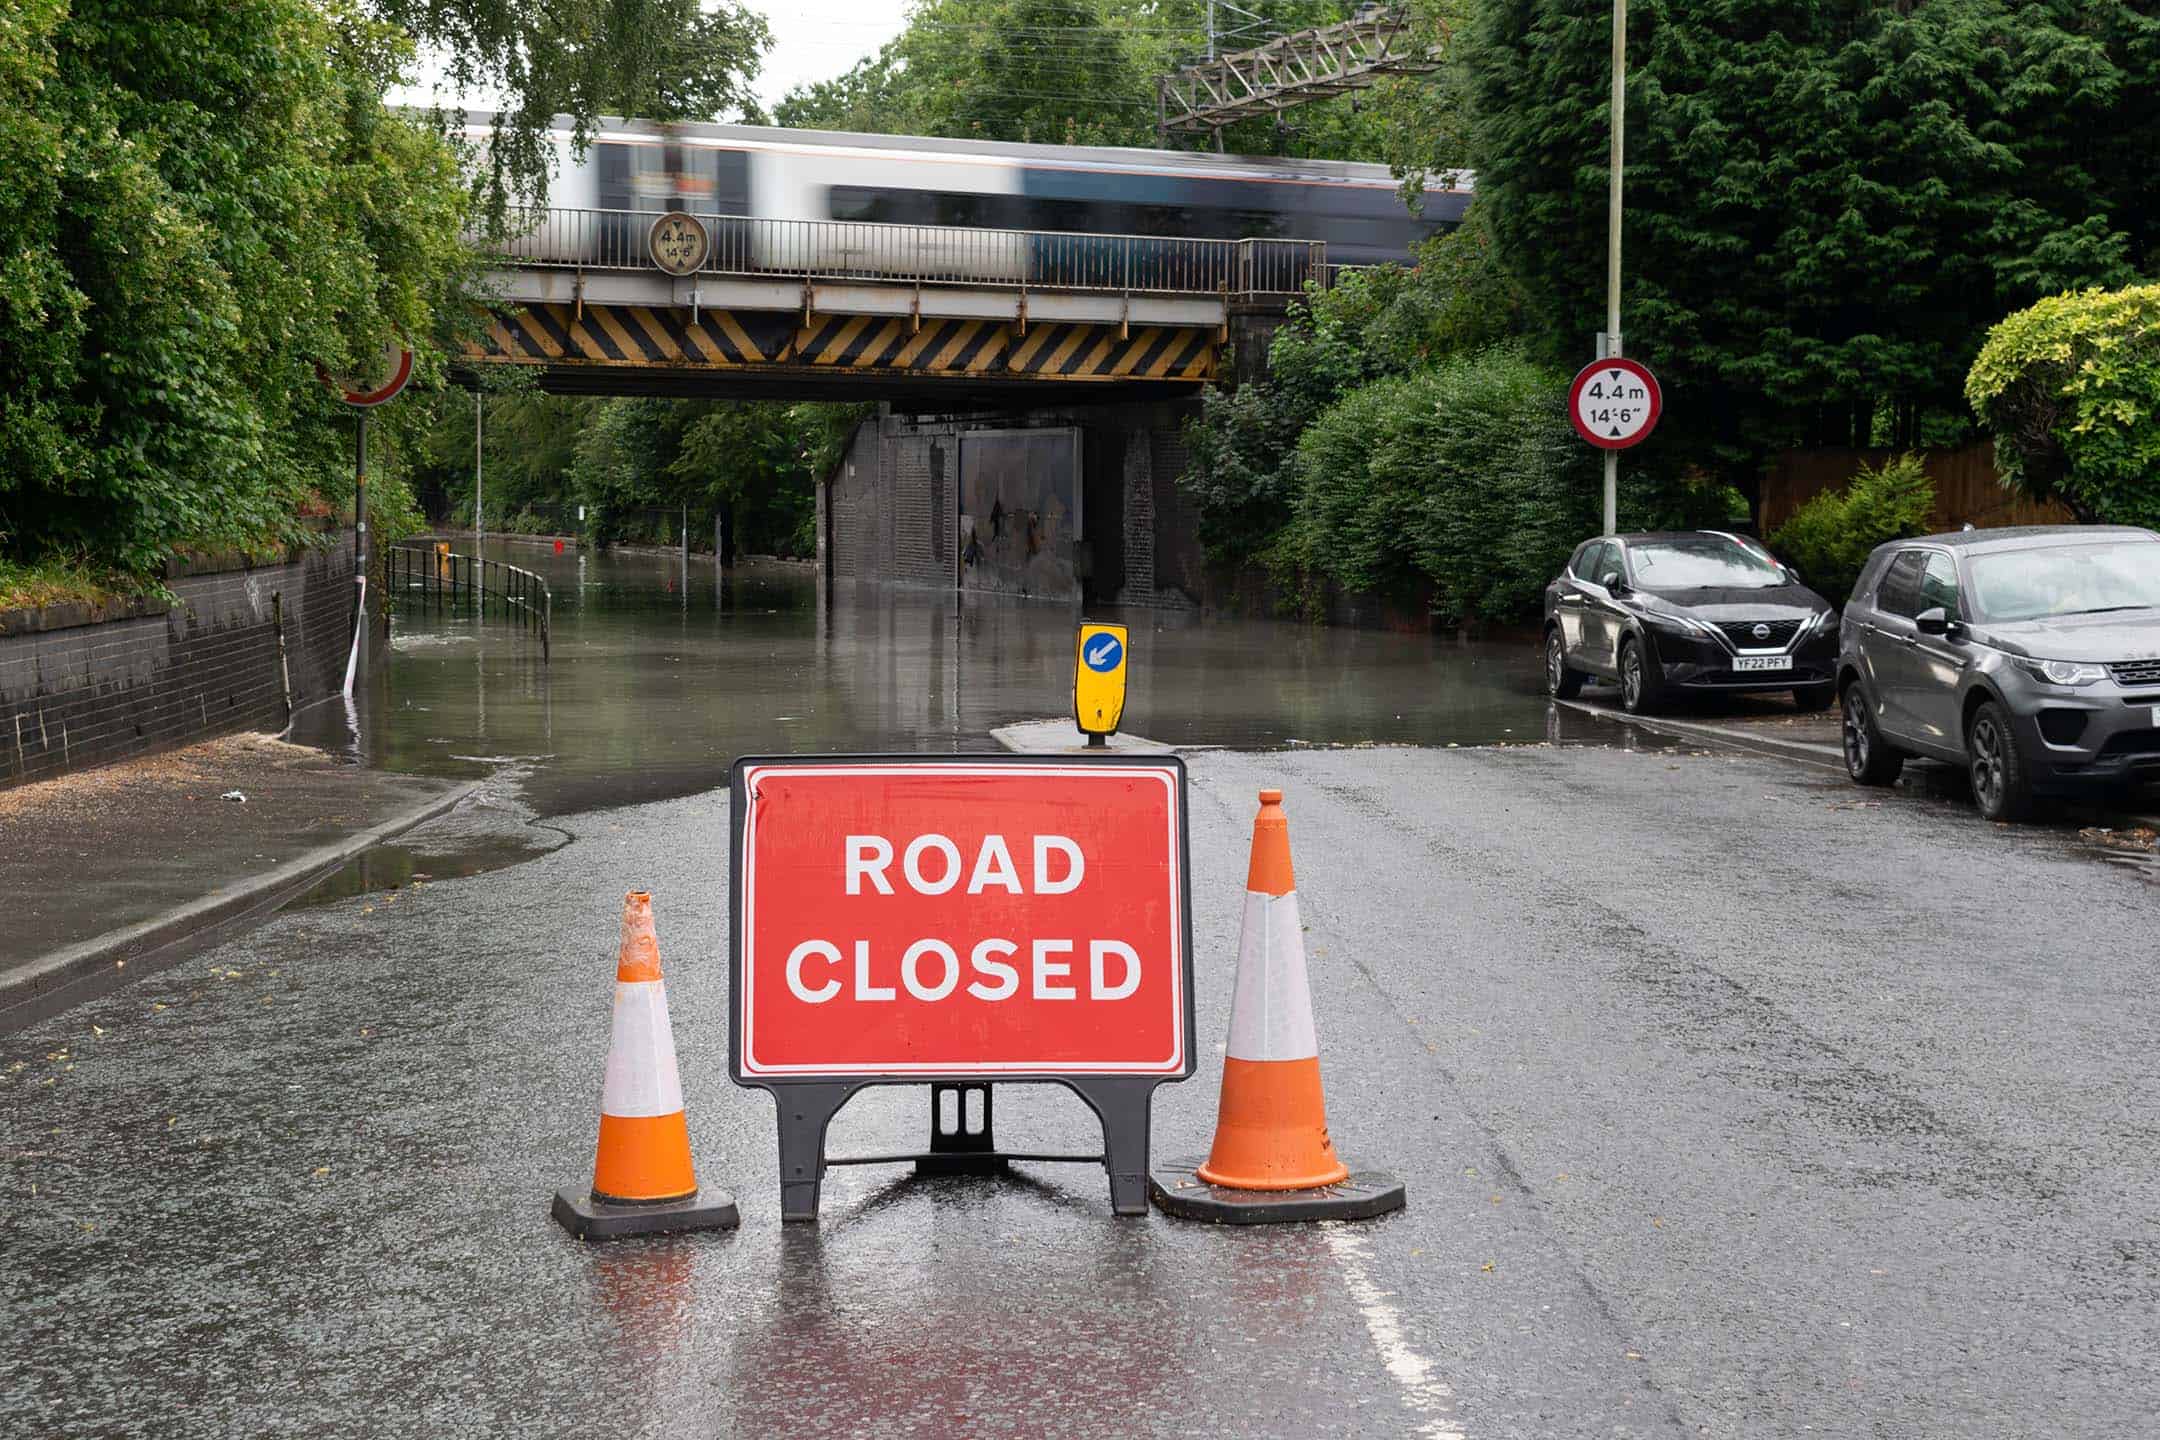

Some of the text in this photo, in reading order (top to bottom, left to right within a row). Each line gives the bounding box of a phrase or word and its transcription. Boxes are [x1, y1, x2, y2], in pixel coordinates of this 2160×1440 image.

[1738, 659, 1765, 669] YF22
[845, 833, 1085, 896] ROAD
[785, 938, 1142, 1004] CLOSED
